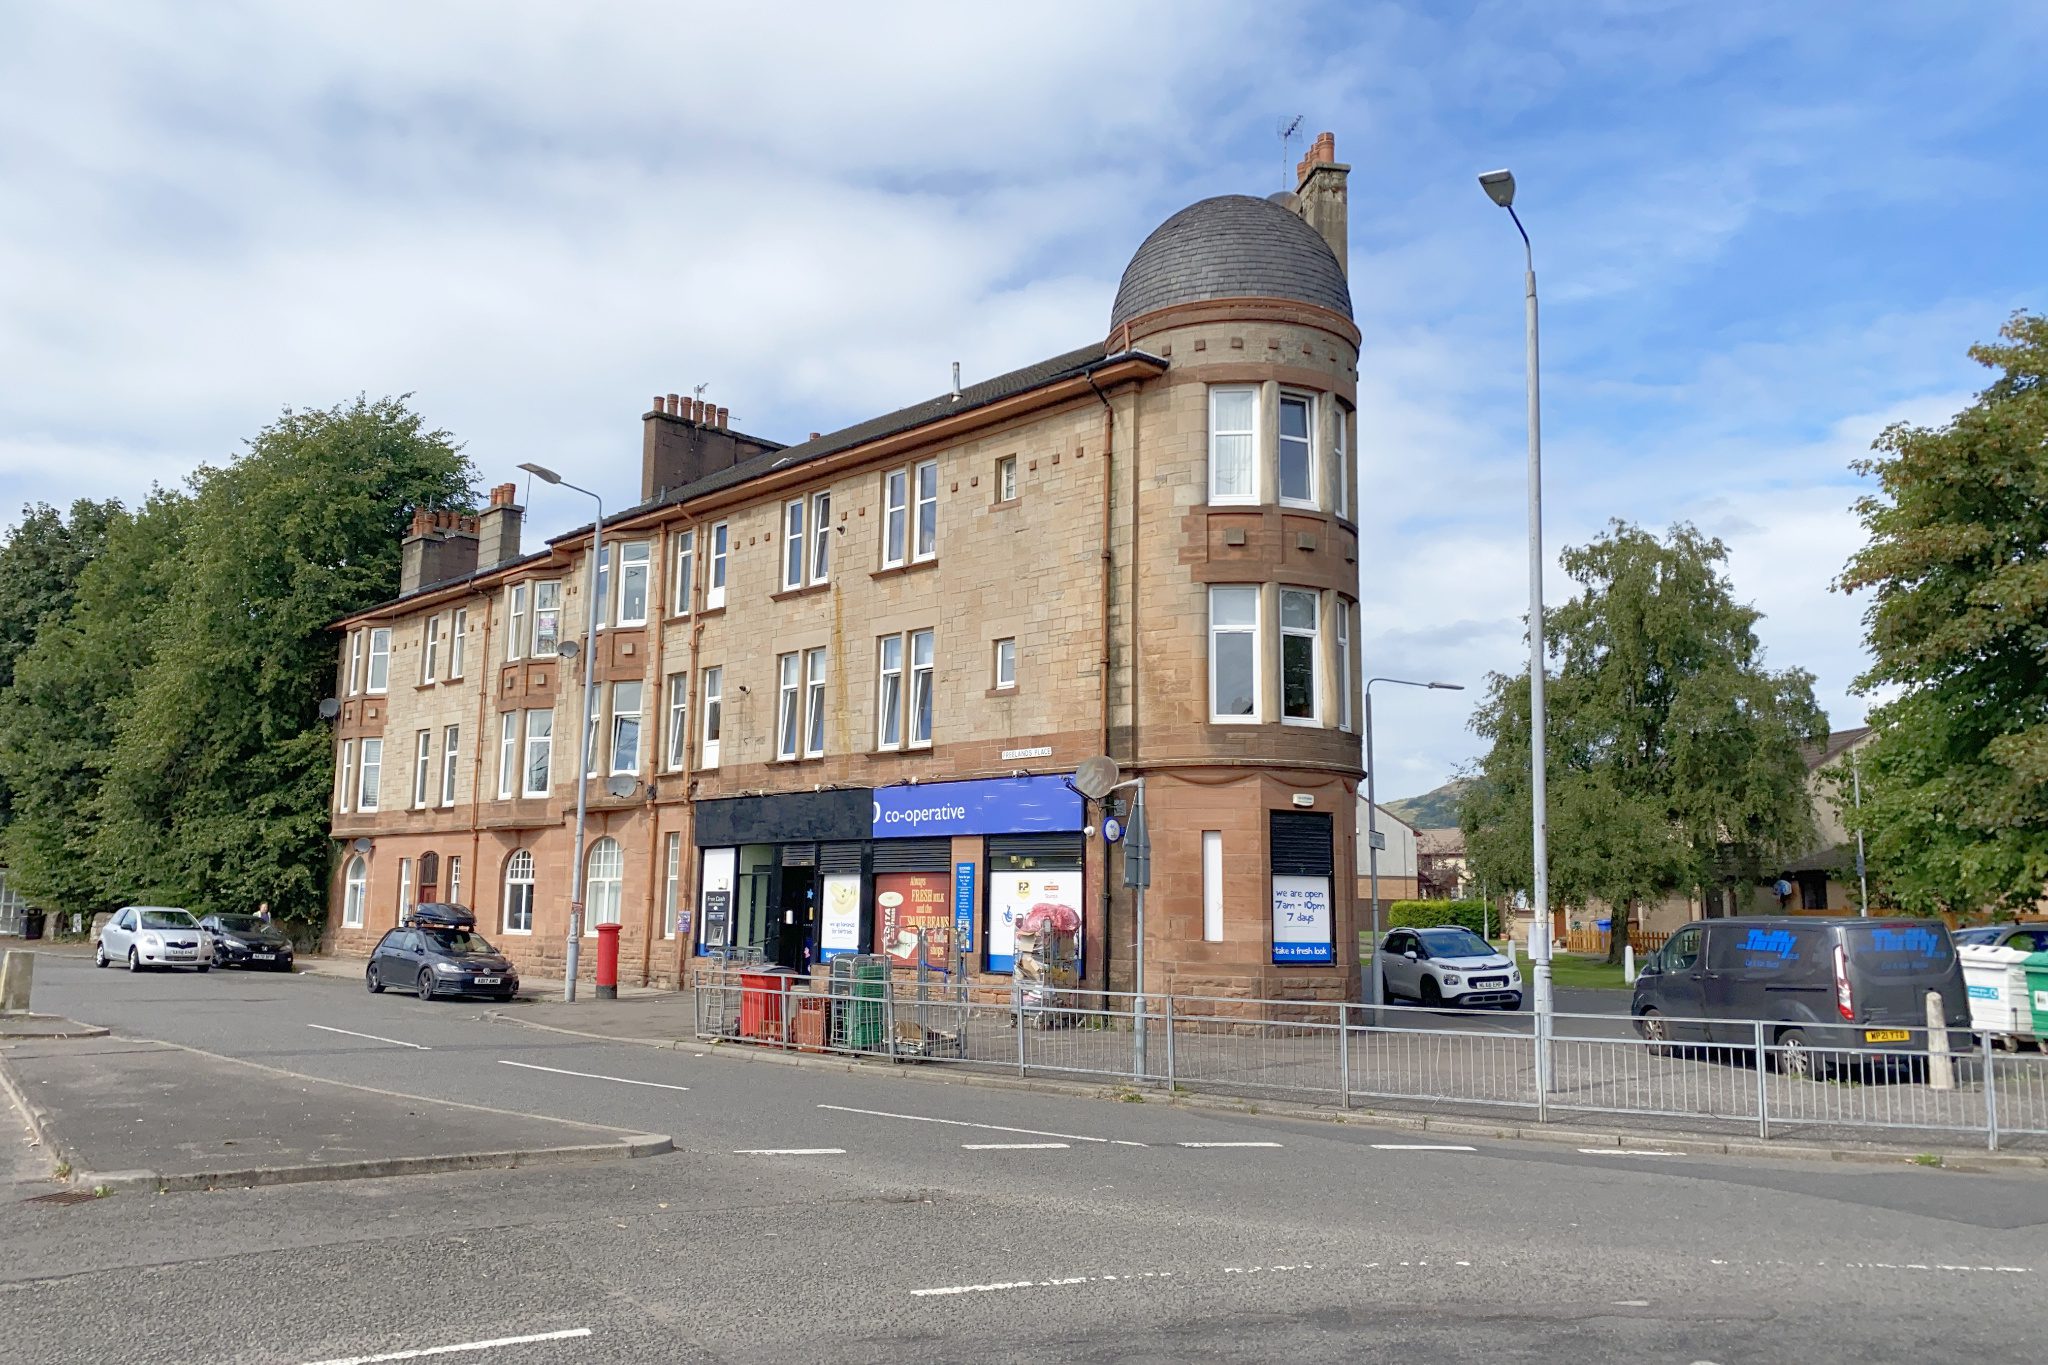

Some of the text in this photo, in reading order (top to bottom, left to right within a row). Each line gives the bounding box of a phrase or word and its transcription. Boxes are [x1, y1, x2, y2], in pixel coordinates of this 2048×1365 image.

[1003, 748, 1051, 759] FREELANDS PLACE
[885, 803, 965, 827] co-operative
[910, 876, 926, 887] Always
[912, 889, 932, 902] FRESH
[1305, 892, 1323, 900] open
[1275, 901, 1295, 909] 7am
[1304, 901, 1325, 912] 10pm
[1287, 913, 1314, 924] 7 days
